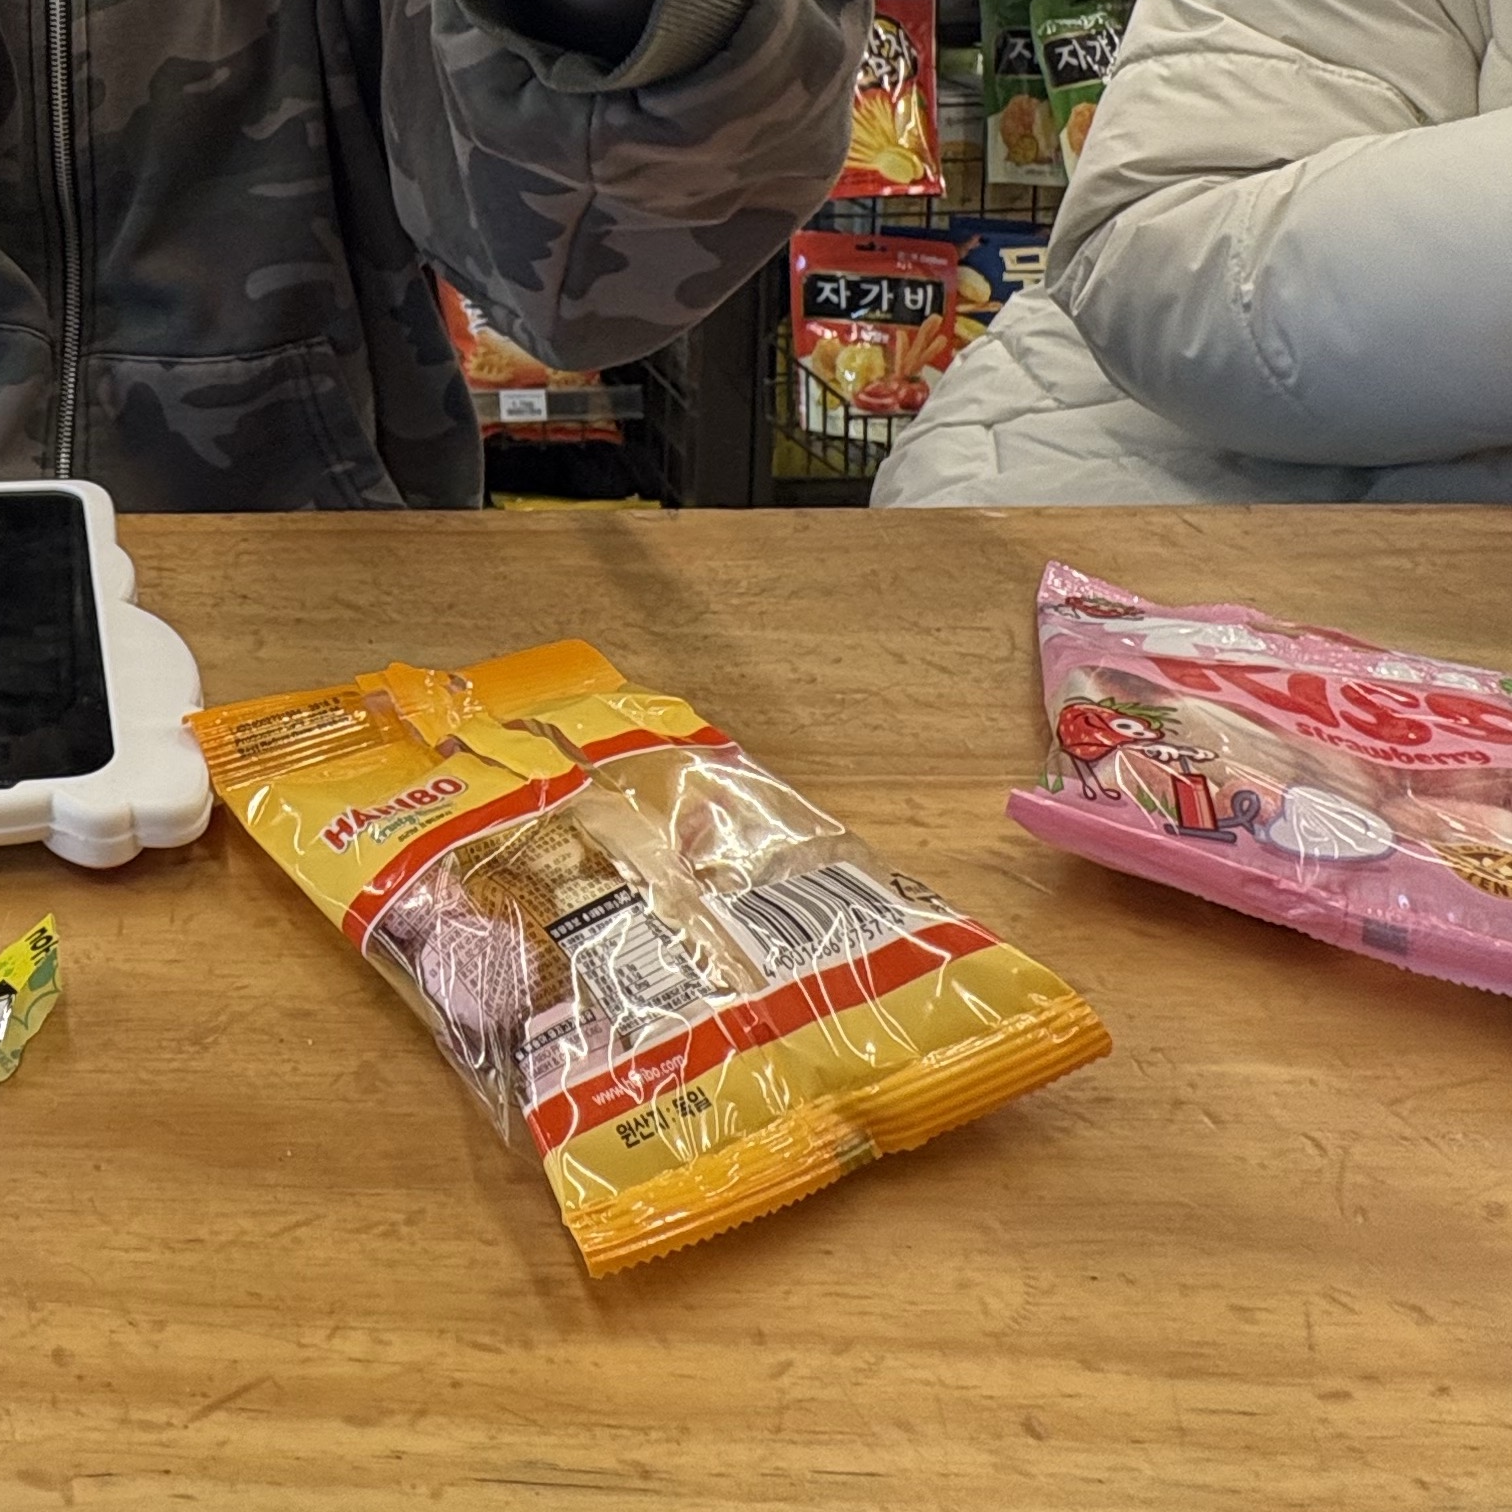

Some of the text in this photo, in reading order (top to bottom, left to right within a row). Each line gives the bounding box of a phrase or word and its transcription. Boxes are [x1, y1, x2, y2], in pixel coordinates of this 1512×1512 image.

[815, 279, 935, 317] 자가비
[1294, 721, 1491, 766] strawberry
[322, 775, 469, 854] HARIBO
[591, 1054, 687, 1108] www.haribo.com
